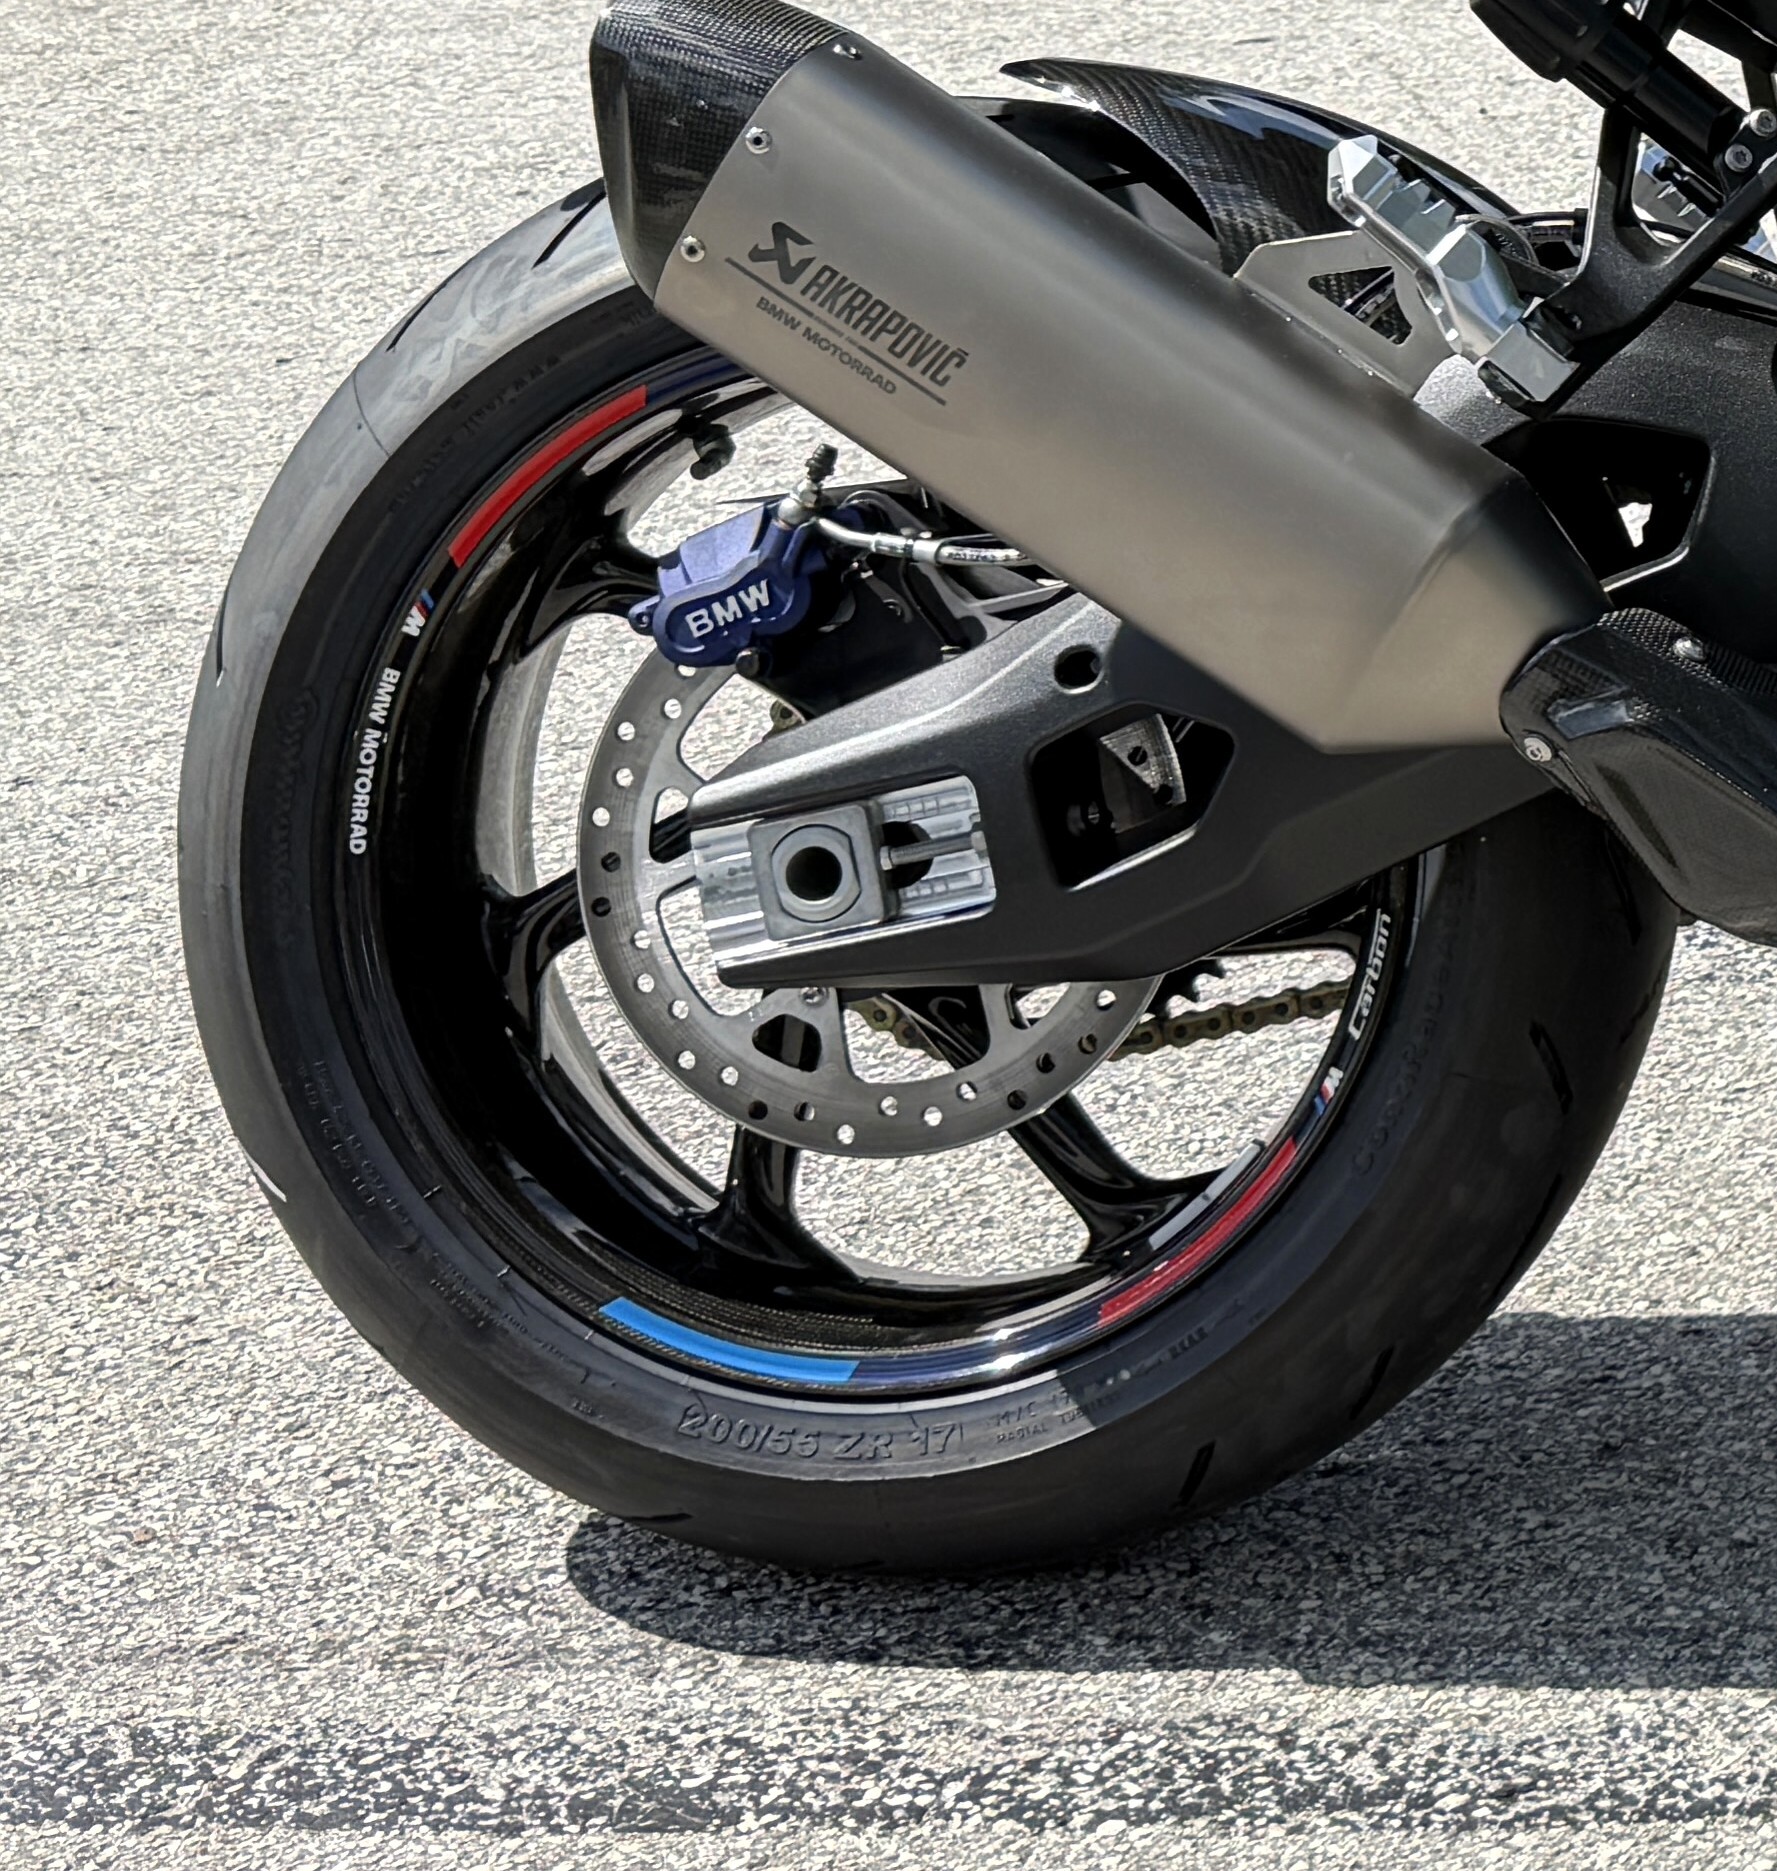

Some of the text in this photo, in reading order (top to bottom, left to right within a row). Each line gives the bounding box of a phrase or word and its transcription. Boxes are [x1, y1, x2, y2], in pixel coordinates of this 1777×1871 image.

[756, 296, 801, 331] BMW
[802, 325, 897, 395] MOTORRAD
[685, 579, 770, 638] BMW
[349, 667, 401, 855] BMW MOTORRAD
[1349, 908, 1391, 1040] Carbon
[677, 1403, 820, 1459] 200/55
[832, 1432, 893, 1460] ZR
